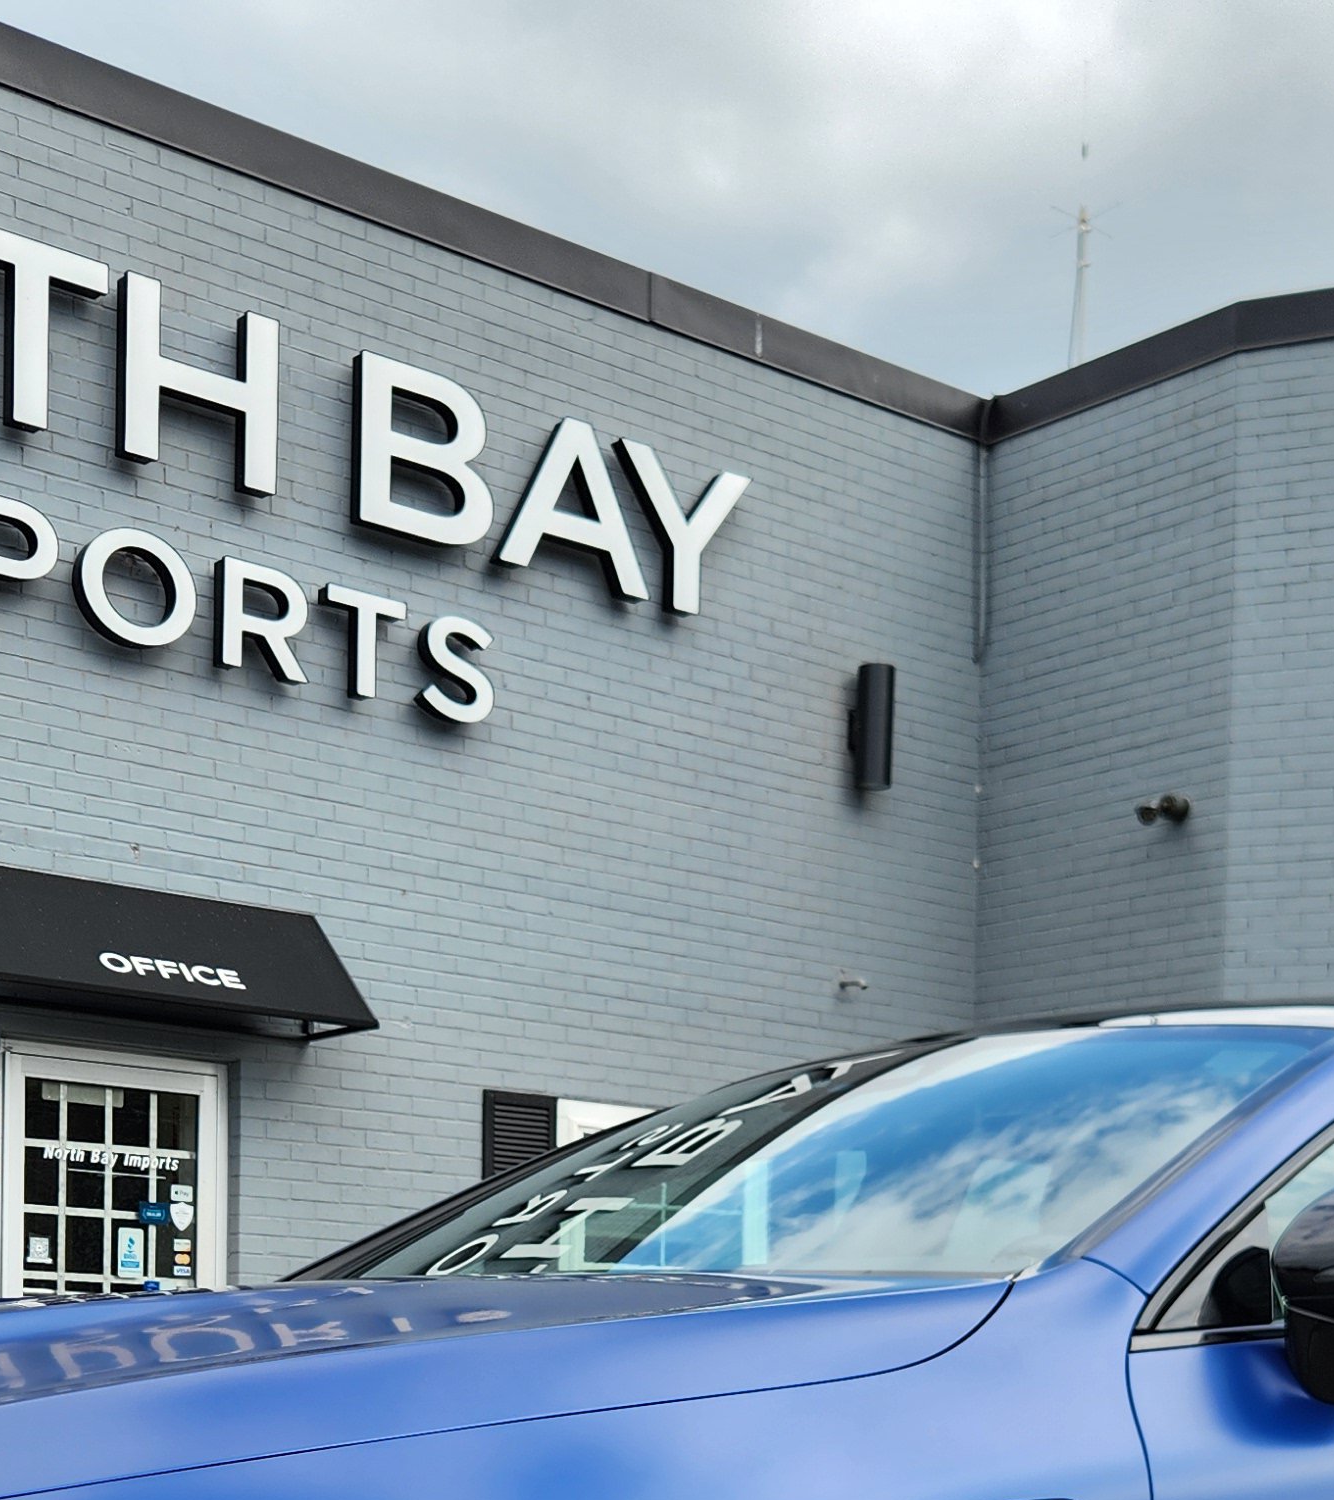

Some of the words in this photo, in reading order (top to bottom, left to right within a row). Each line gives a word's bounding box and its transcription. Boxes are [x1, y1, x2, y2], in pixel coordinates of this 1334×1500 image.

[352, 348, 752, 616] BAY
[98, 951, 247, 990] OFFICE
[43, 1146, 86, 1163] North
[90, 1149, 119, 1169] Bay
[123, 1152, 180, 1171] Imports
